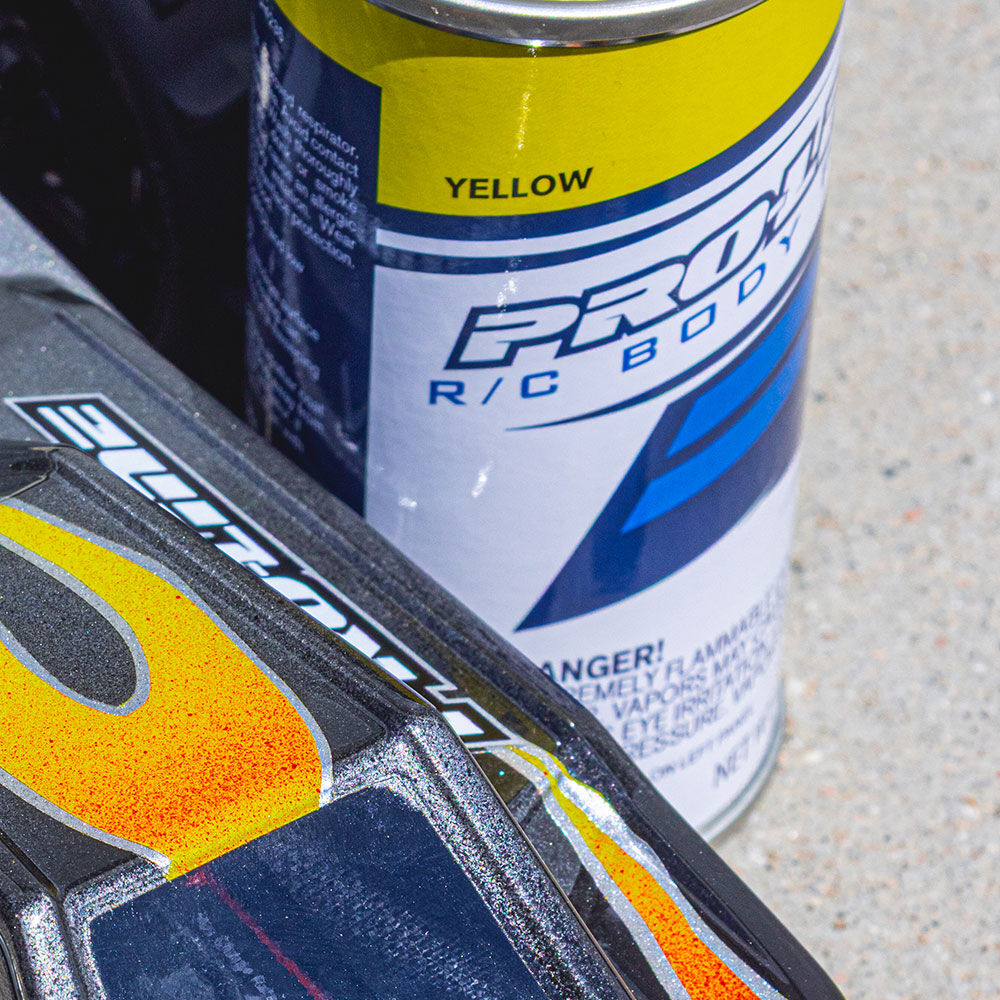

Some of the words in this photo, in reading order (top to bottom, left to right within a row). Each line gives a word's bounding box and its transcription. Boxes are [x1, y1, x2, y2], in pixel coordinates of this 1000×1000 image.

[445, 166, 595, 200] YELLOW
[428, 370, 560, 406] R/C
[621, 214, 800, 374] BODY
[541, 638, 665, 683] ANGER!
